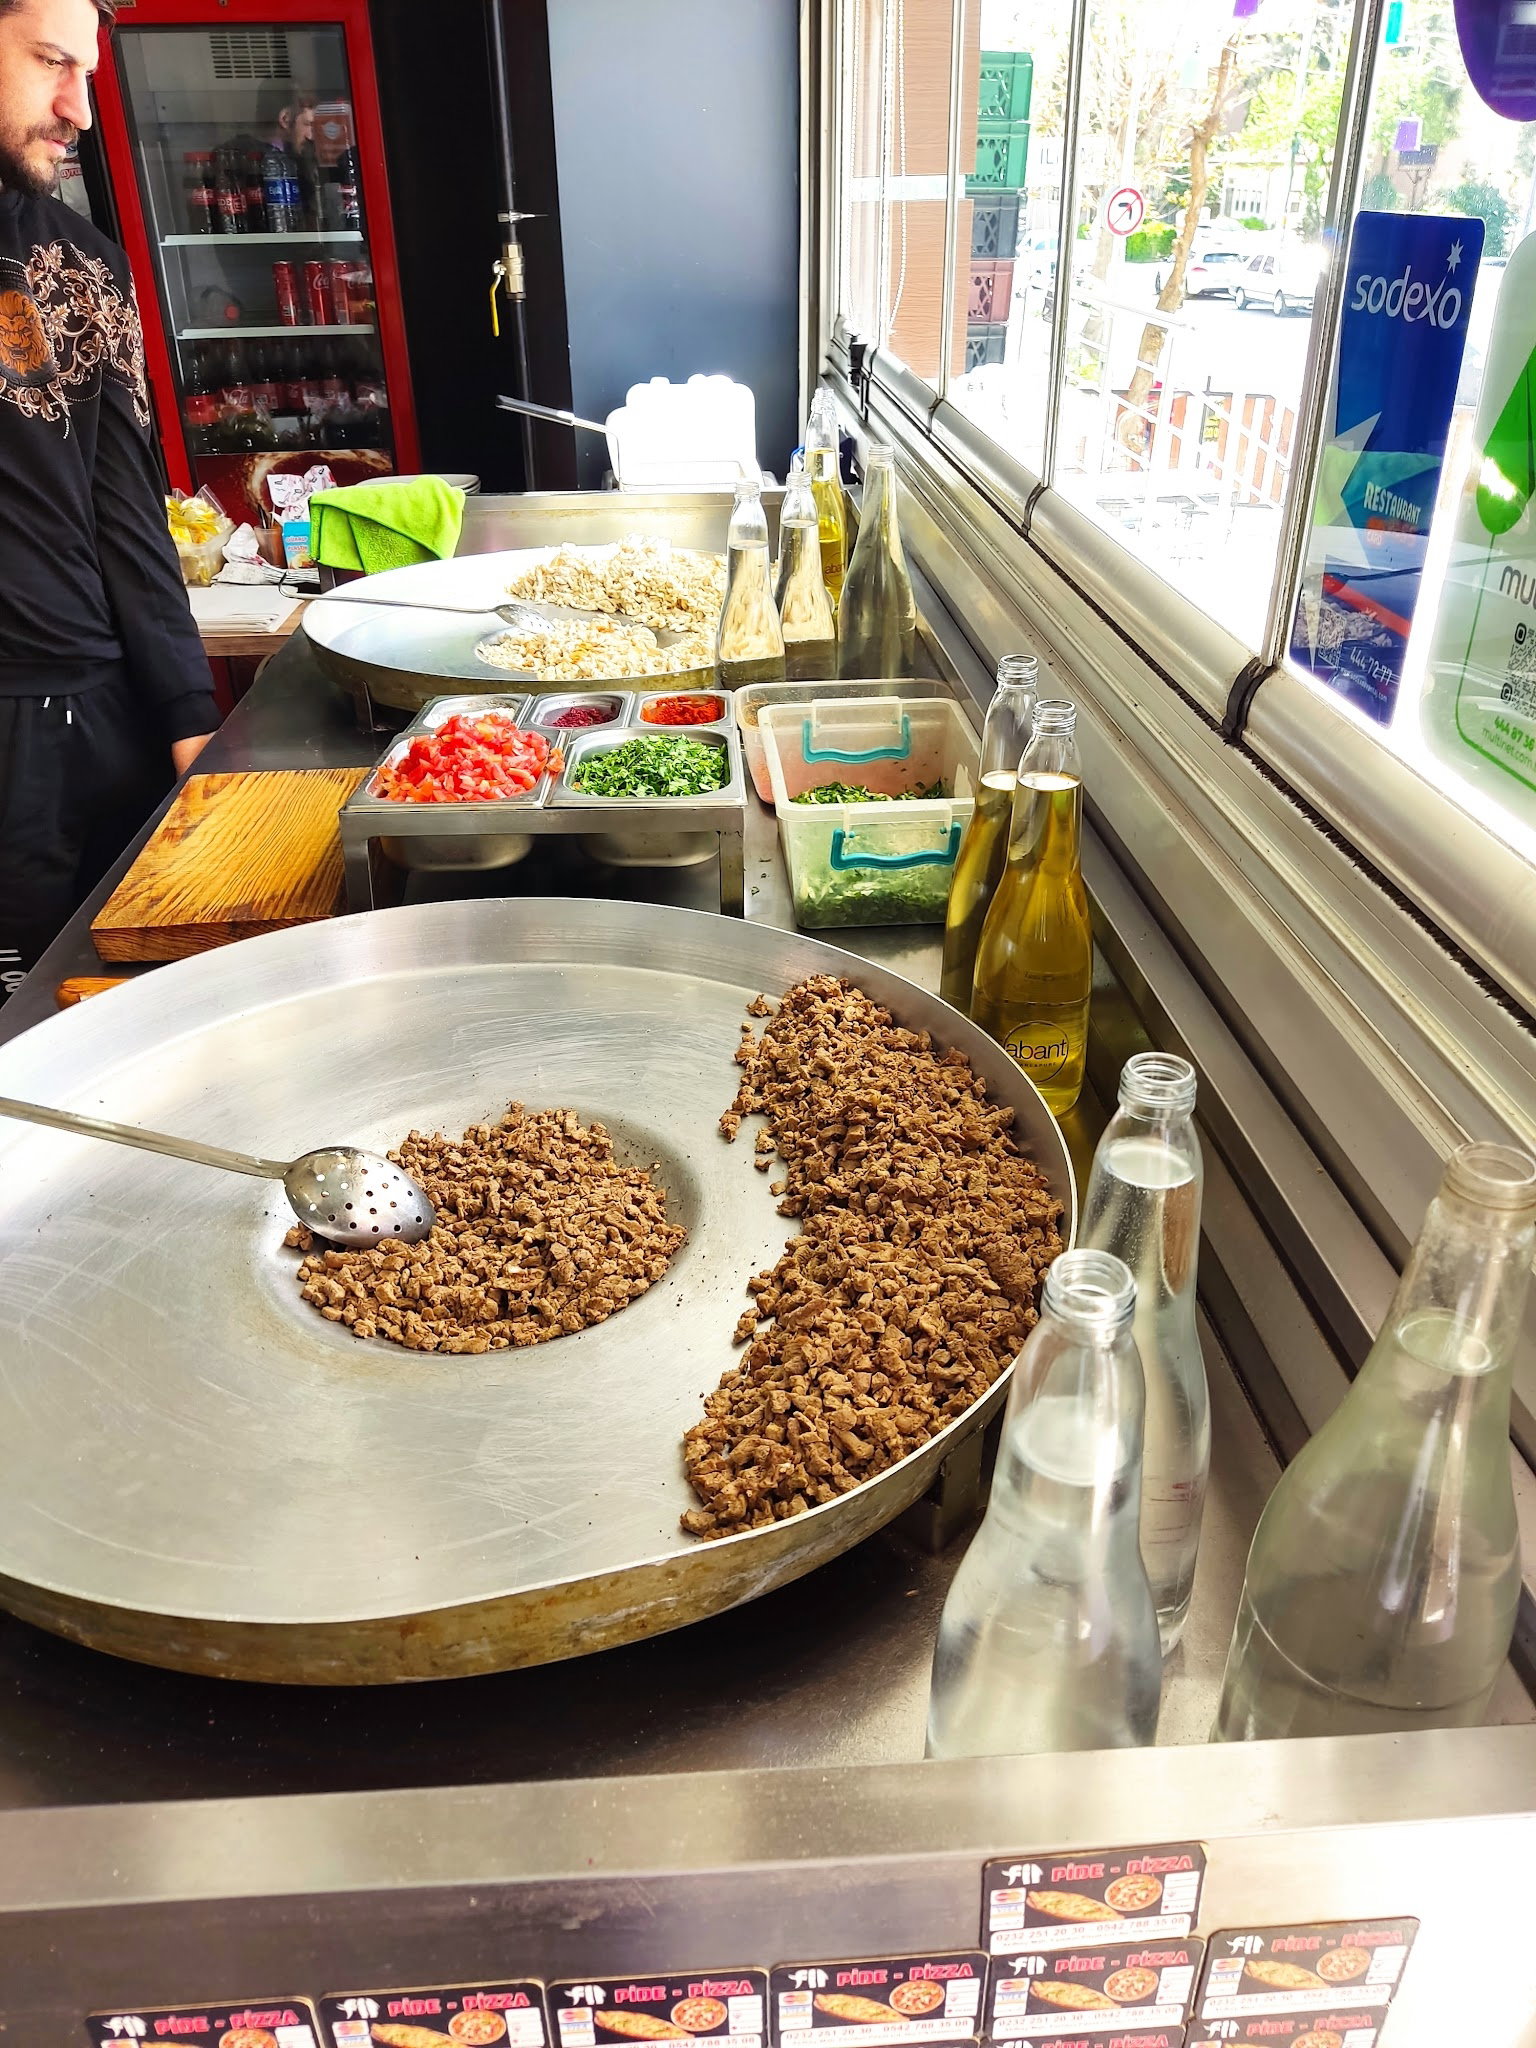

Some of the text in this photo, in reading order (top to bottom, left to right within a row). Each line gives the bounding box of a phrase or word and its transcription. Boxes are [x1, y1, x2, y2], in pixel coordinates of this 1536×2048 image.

[61, 168, 82, 179] ayra
[1351, 265, 1461, 329] sodexo
[1364, 481, 1421, 524] RESTAURANT
[1351, 647, 1365, 671] 444
[1481, 728, 1536, 772] multinet.com
[1005, 1039, 1067, 1060] abant
